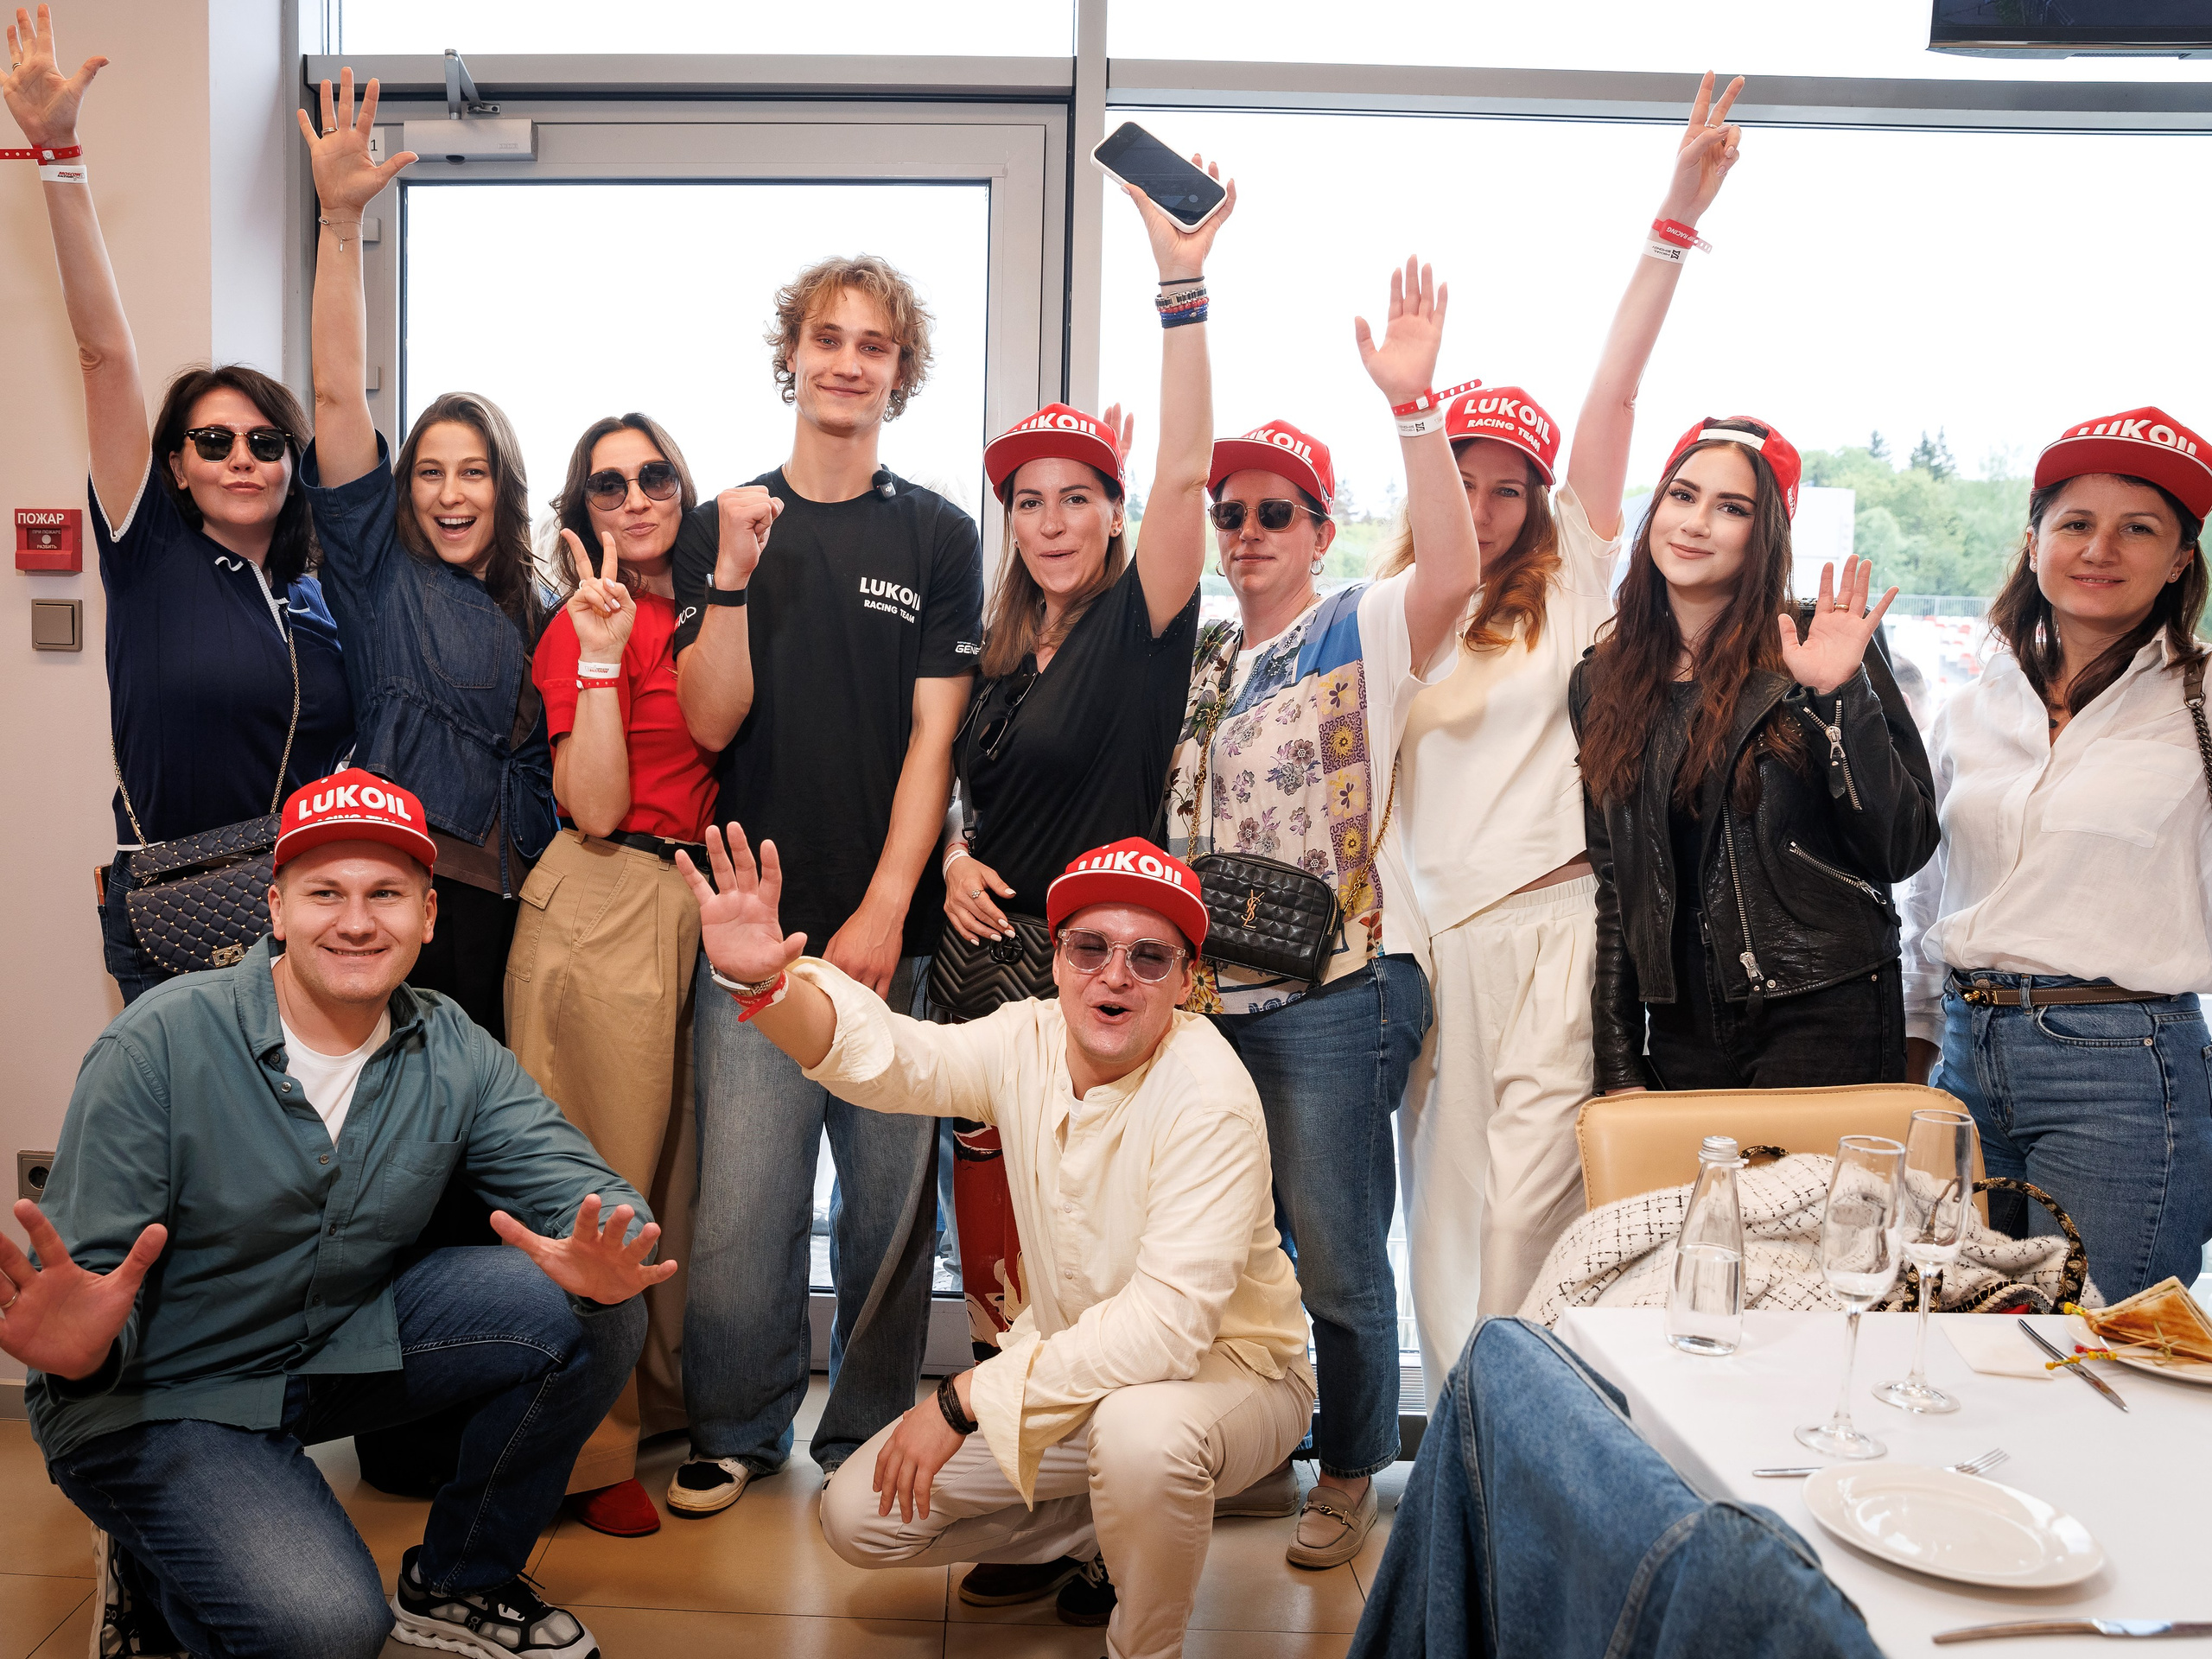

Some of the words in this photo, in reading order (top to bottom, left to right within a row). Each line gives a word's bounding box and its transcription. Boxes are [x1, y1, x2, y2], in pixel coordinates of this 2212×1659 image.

[1666, 226, 1688, 240] RACING
[1463, 397, 1551, 446] LUKOIL
[1466, 418, 1516, 431] RACING
[1516, 426, 1541, 454] TEAM
[17, 512, 65, 524] ПОЖАР
[864, 599, 899, 614] RACING
[899, 608, 916, 624] TEAM
[298, 784, 412, 822] LUKOIL
